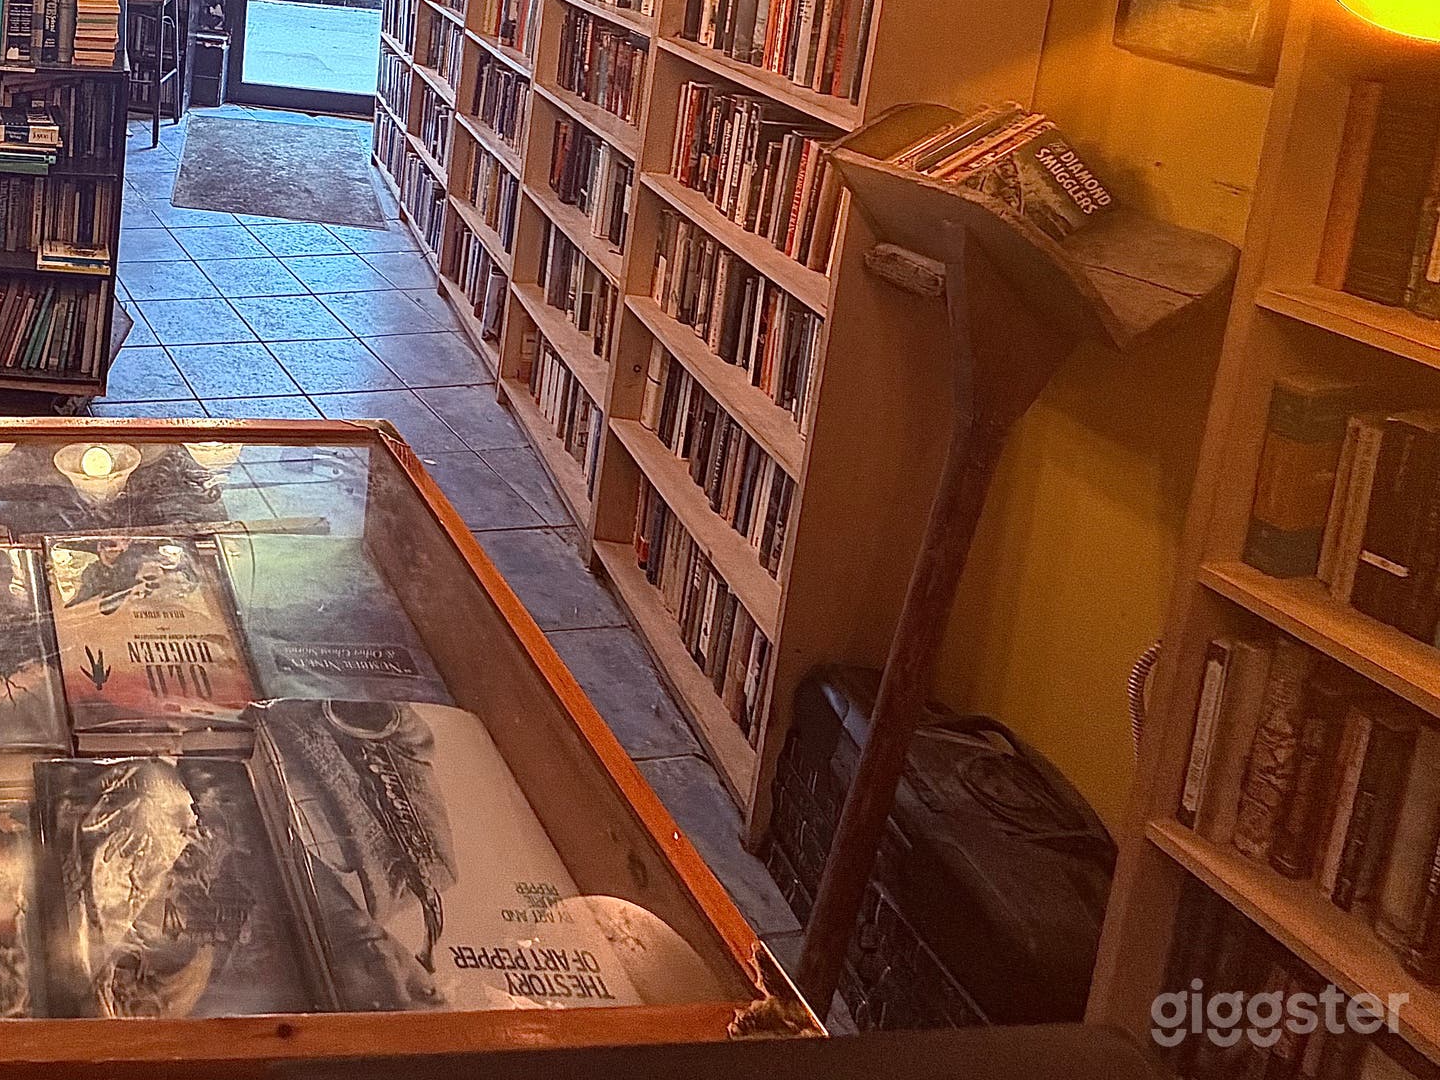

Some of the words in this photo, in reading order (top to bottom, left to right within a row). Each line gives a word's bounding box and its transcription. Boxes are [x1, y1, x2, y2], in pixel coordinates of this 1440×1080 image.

[1035, 147, 1098, 214] SMUGGLERS
[1060, 150, 1111, 206] DIAMOND
[127, 640, 212, 663] HOGGEN
[323, 646, 352, 657] Ghost
[352, 648, 384, 658] Other
[515, 882, 559, 896] PEPPER
[501, 908, 529, 923] AND
[449, 946, 531, 971] PEPPER
[530, 948, 570, 971] ART
[572, 950, 601, 973] OF
[504, 972, 573, 998] STORY
[570, 975, 616, 999] THE
